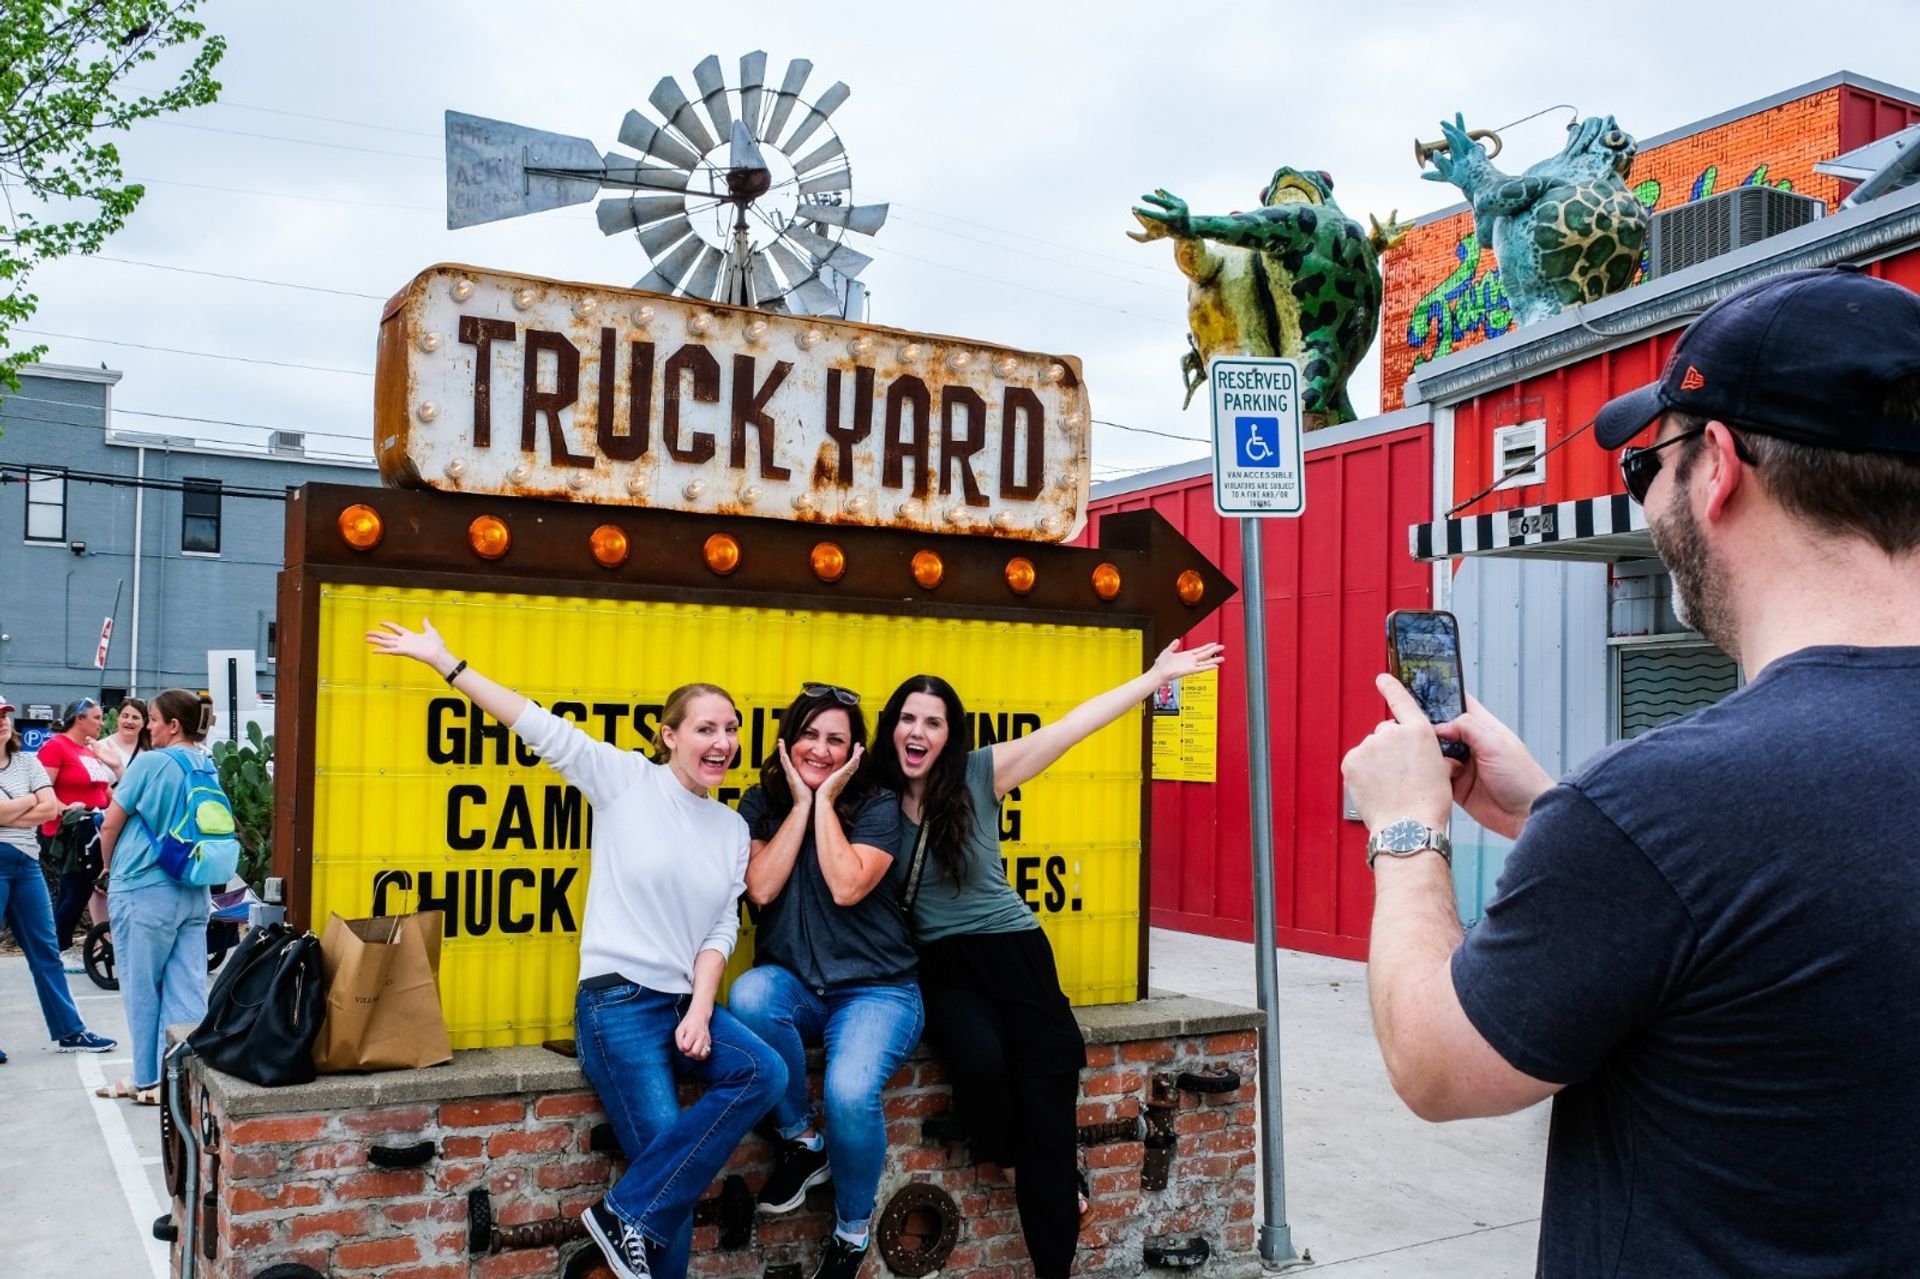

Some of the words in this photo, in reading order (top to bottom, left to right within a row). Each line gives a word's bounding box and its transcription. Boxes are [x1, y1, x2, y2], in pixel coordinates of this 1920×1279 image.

[1218, 371, 1292, 390] RESERVED
[458, 314, 795, 481] TRUCK
[826, 366, 1044, 507] YARD
[1224, 393, 1288, 412] PARKING
[1224, 482, 1256, 490] VIOLATORS
[1257, 482, 1269, 490] ARE
[1270, 482, 1295, 490] SUBJECT
[373, 868, 579, 938] CHUCK
